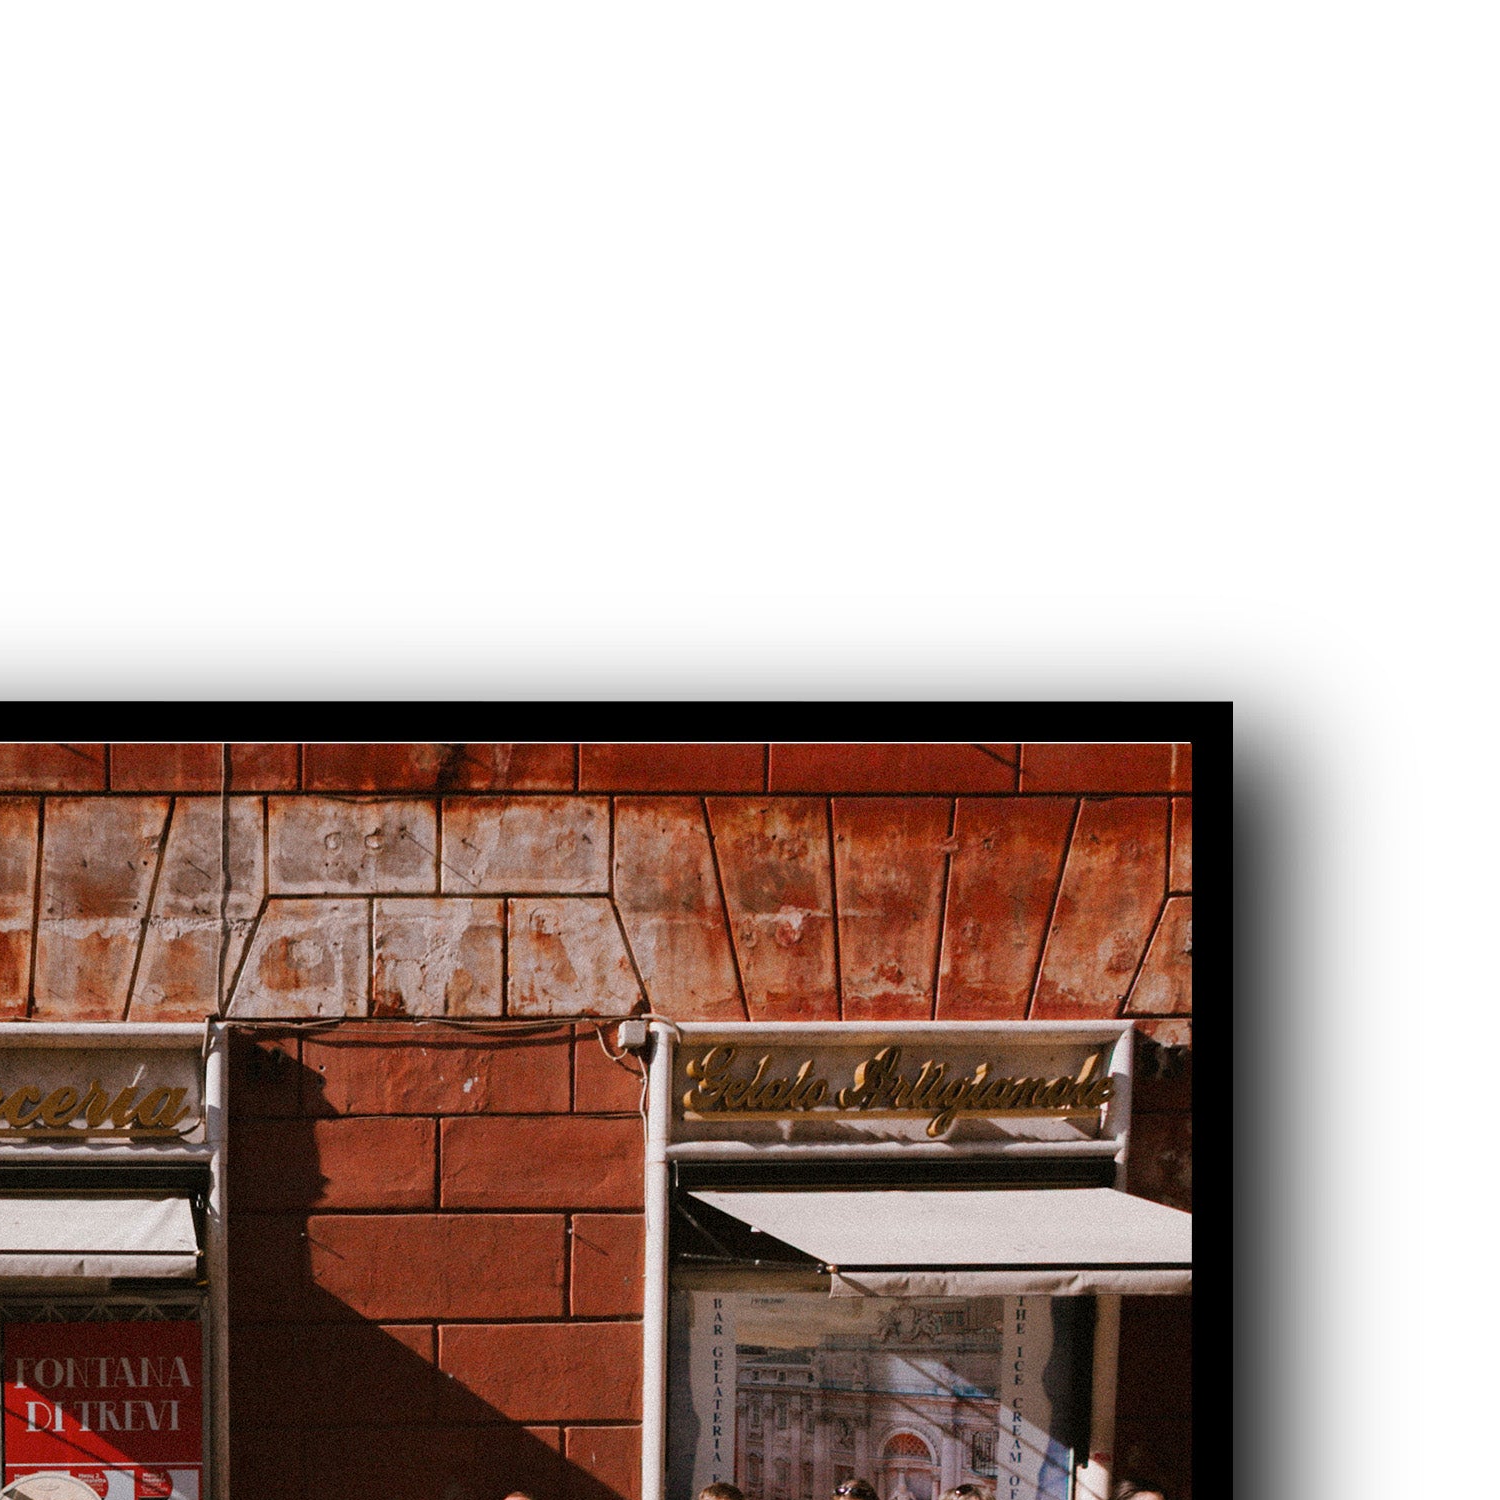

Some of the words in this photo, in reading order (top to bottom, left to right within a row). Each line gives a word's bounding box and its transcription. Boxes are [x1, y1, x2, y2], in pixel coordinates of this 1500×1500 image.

[682, 1043, 830, 1112] Gelato
[836, 1046, 1115, 1137] Artigianale
[712, 1297, 724, 1336] BAR
[13, 1356, 194, 1389] FONTANA
[1013, 1346, 1025, 1387] ICE
[25, 1400, 66, 1433] DI
[73, 1400, 181, 1432] TREVI
[711, 1346, 724, 1463] GELATERIA
[1009, 1396, 1024, 1464] CREAM
[1008, 1476, 1021, 1500] OF
